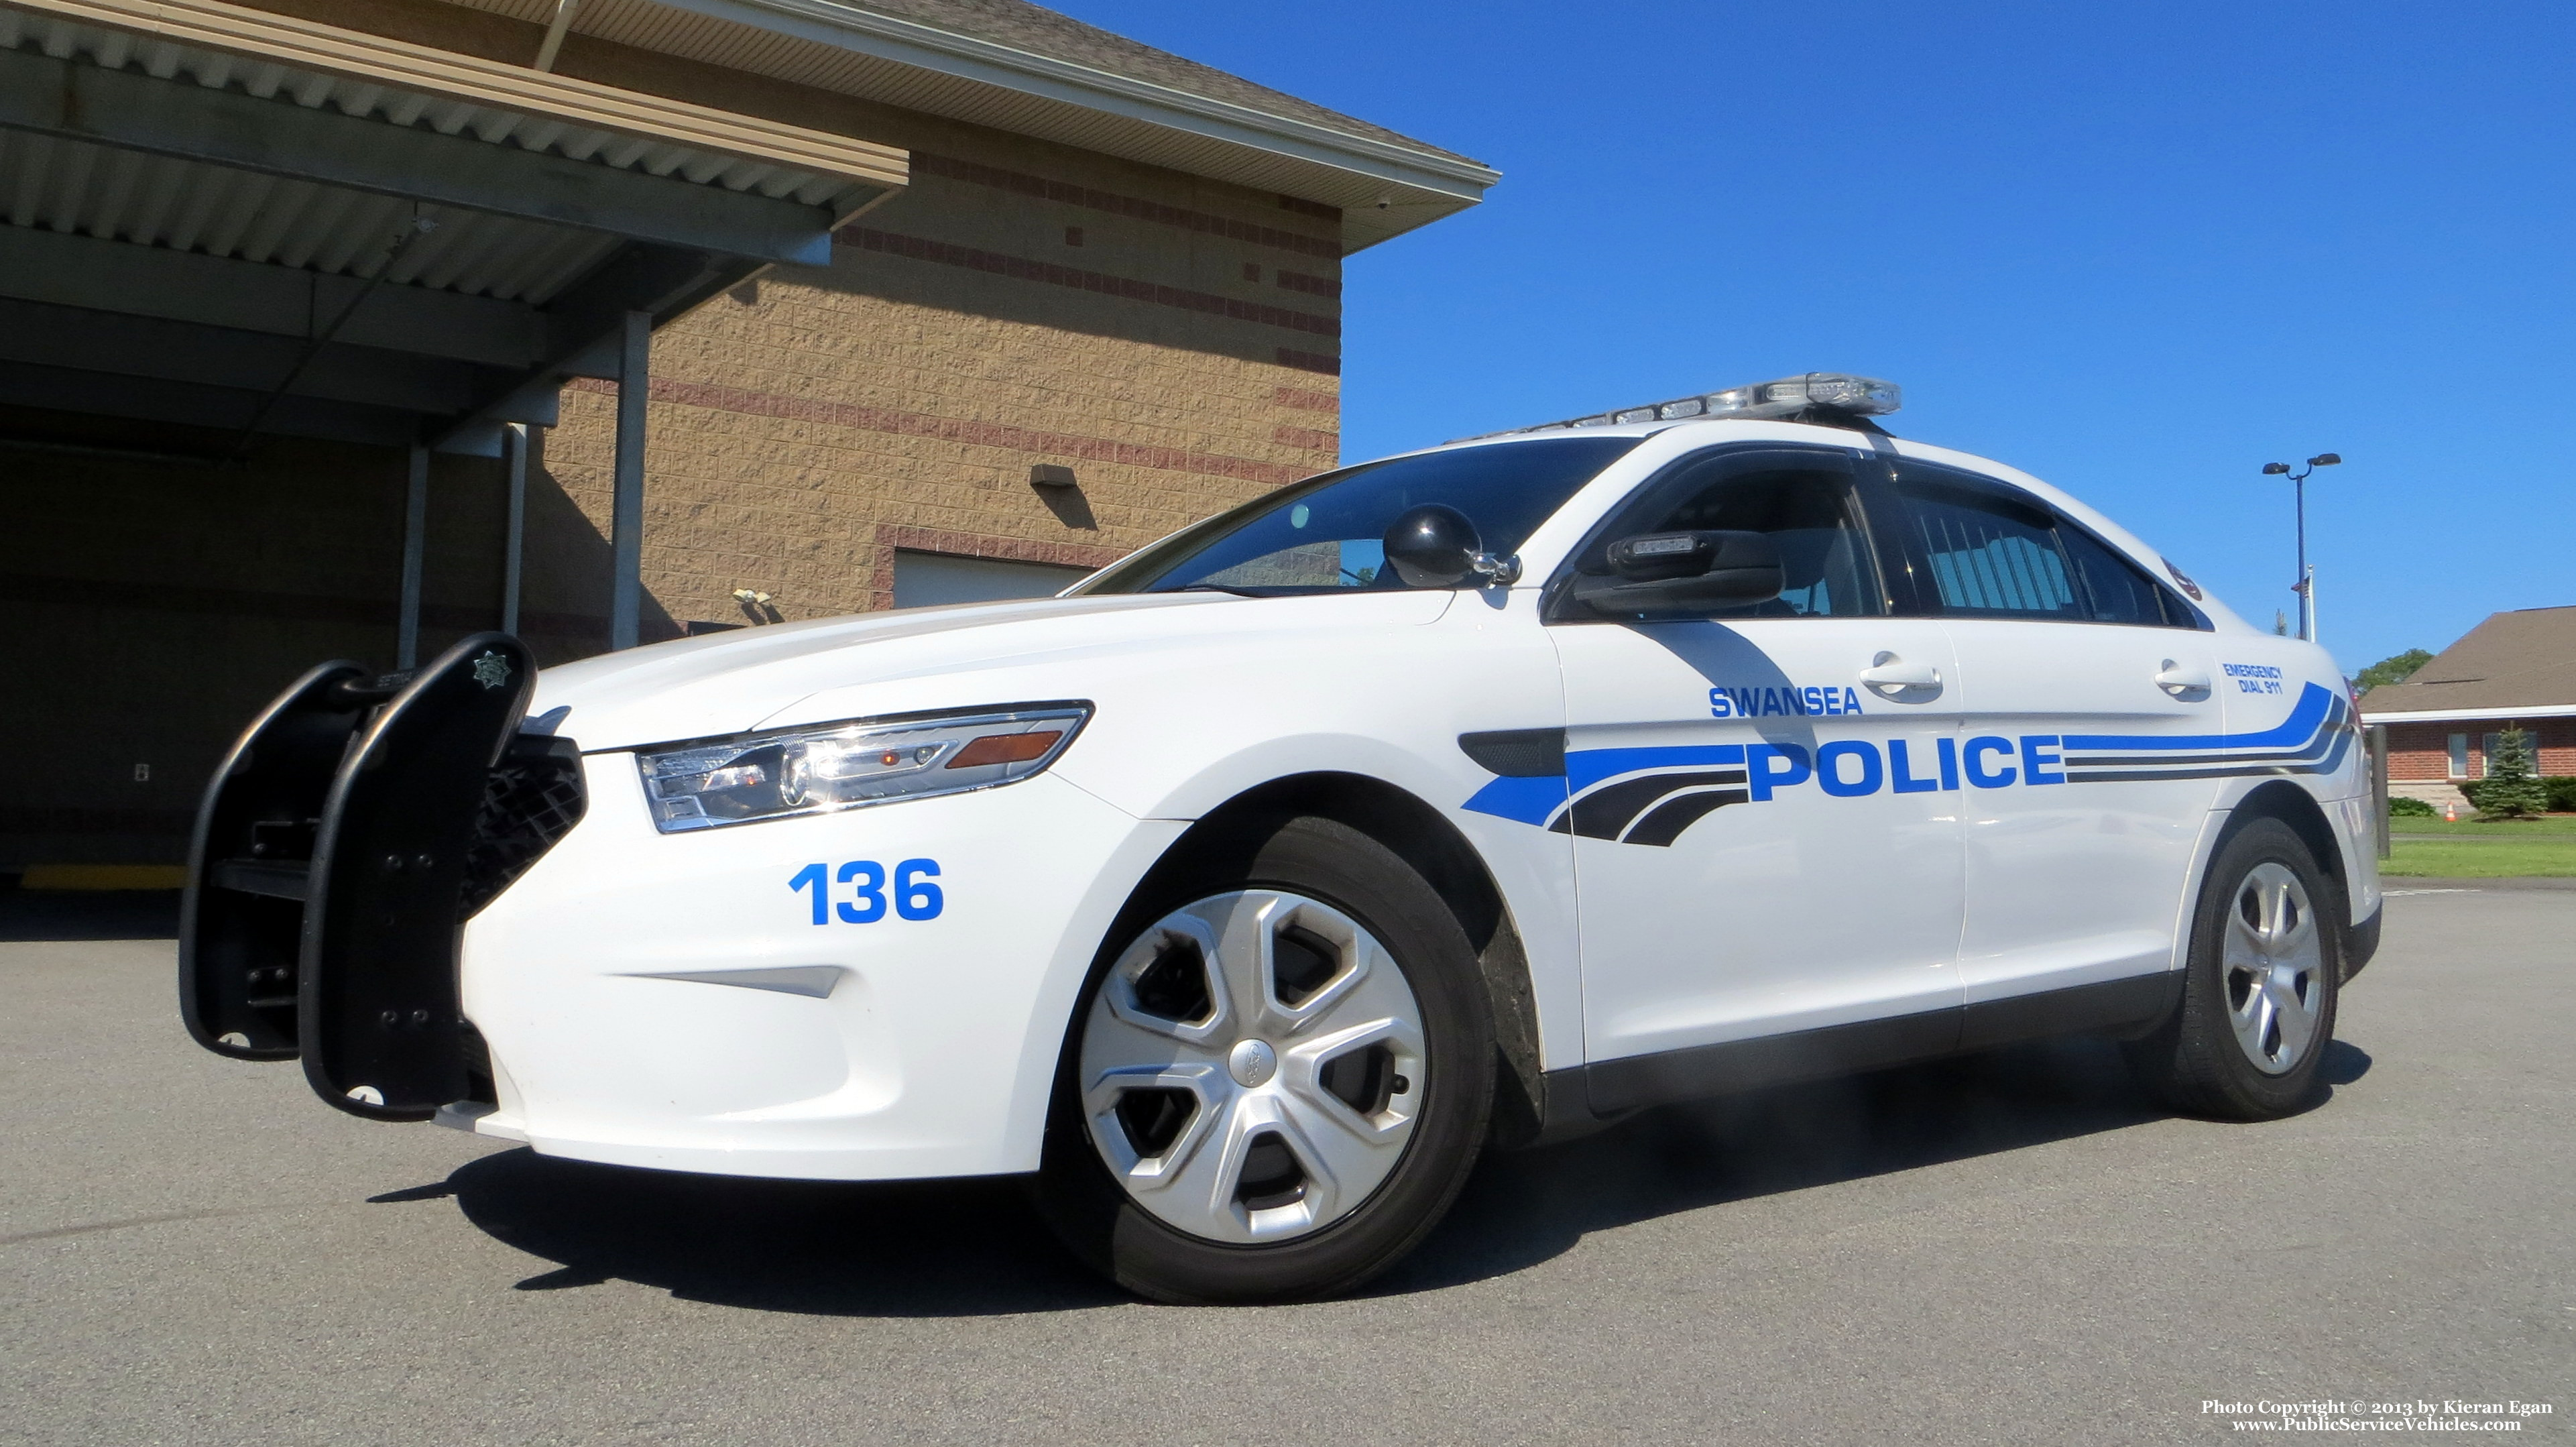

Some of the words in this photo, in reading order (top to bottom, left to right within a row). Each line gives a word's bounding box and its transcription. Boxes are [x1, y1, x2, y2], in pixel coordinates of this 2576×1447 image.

[2222, 662, 2283, 679] EMERGENCY
[1708, 686, 1863, 718] SWANSEA
[2237, 679, 2264, 693] DIAL
[2264, 681, 2283, 695] 911
[1745, 735, 2066, 802] POLICE
[787, 858, 944, 925] 136
